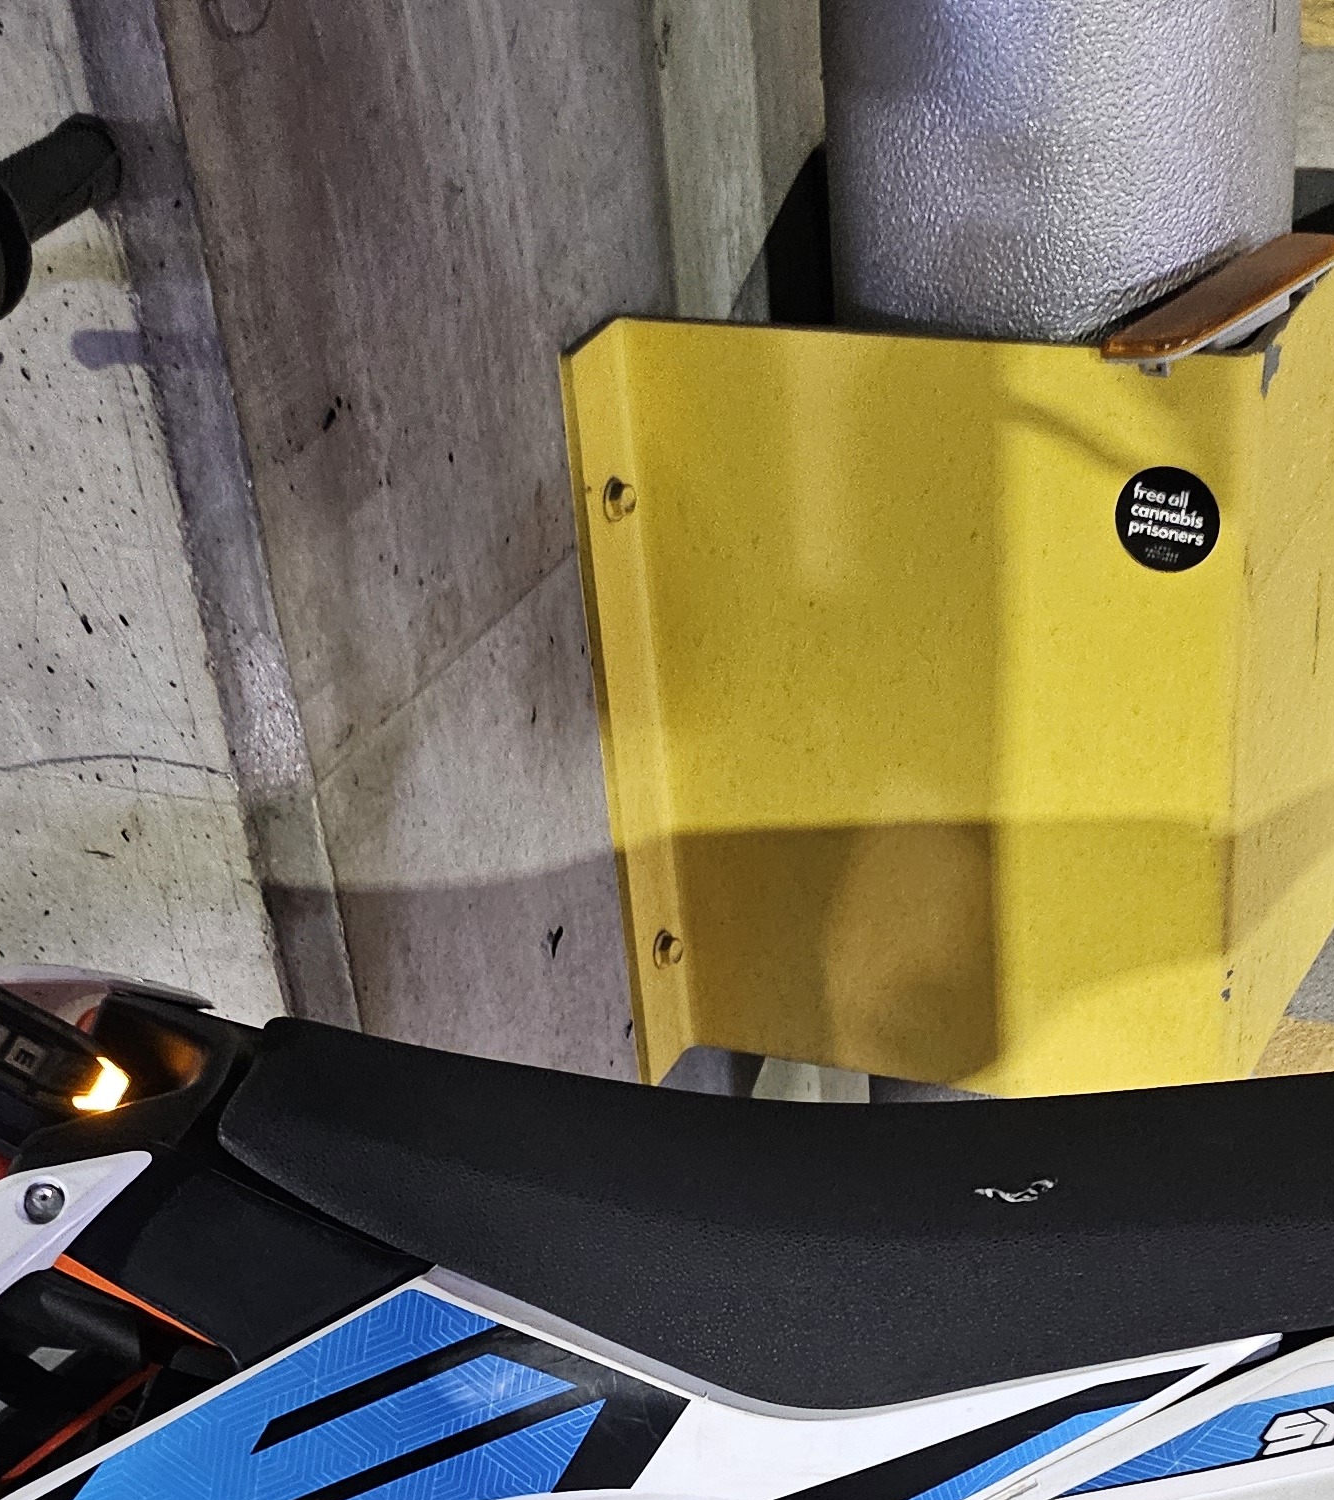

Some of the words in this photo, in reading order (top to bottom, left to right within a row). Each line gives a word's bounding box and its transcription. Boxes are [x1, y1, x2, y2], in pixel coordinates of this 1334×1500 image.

[1133, 481, 1167, 504] free
[1168, 490, 1191, 509] all
[1130, 503, 1204, 529] cannabis
[1127, 520, 1205, 546] prisoners
